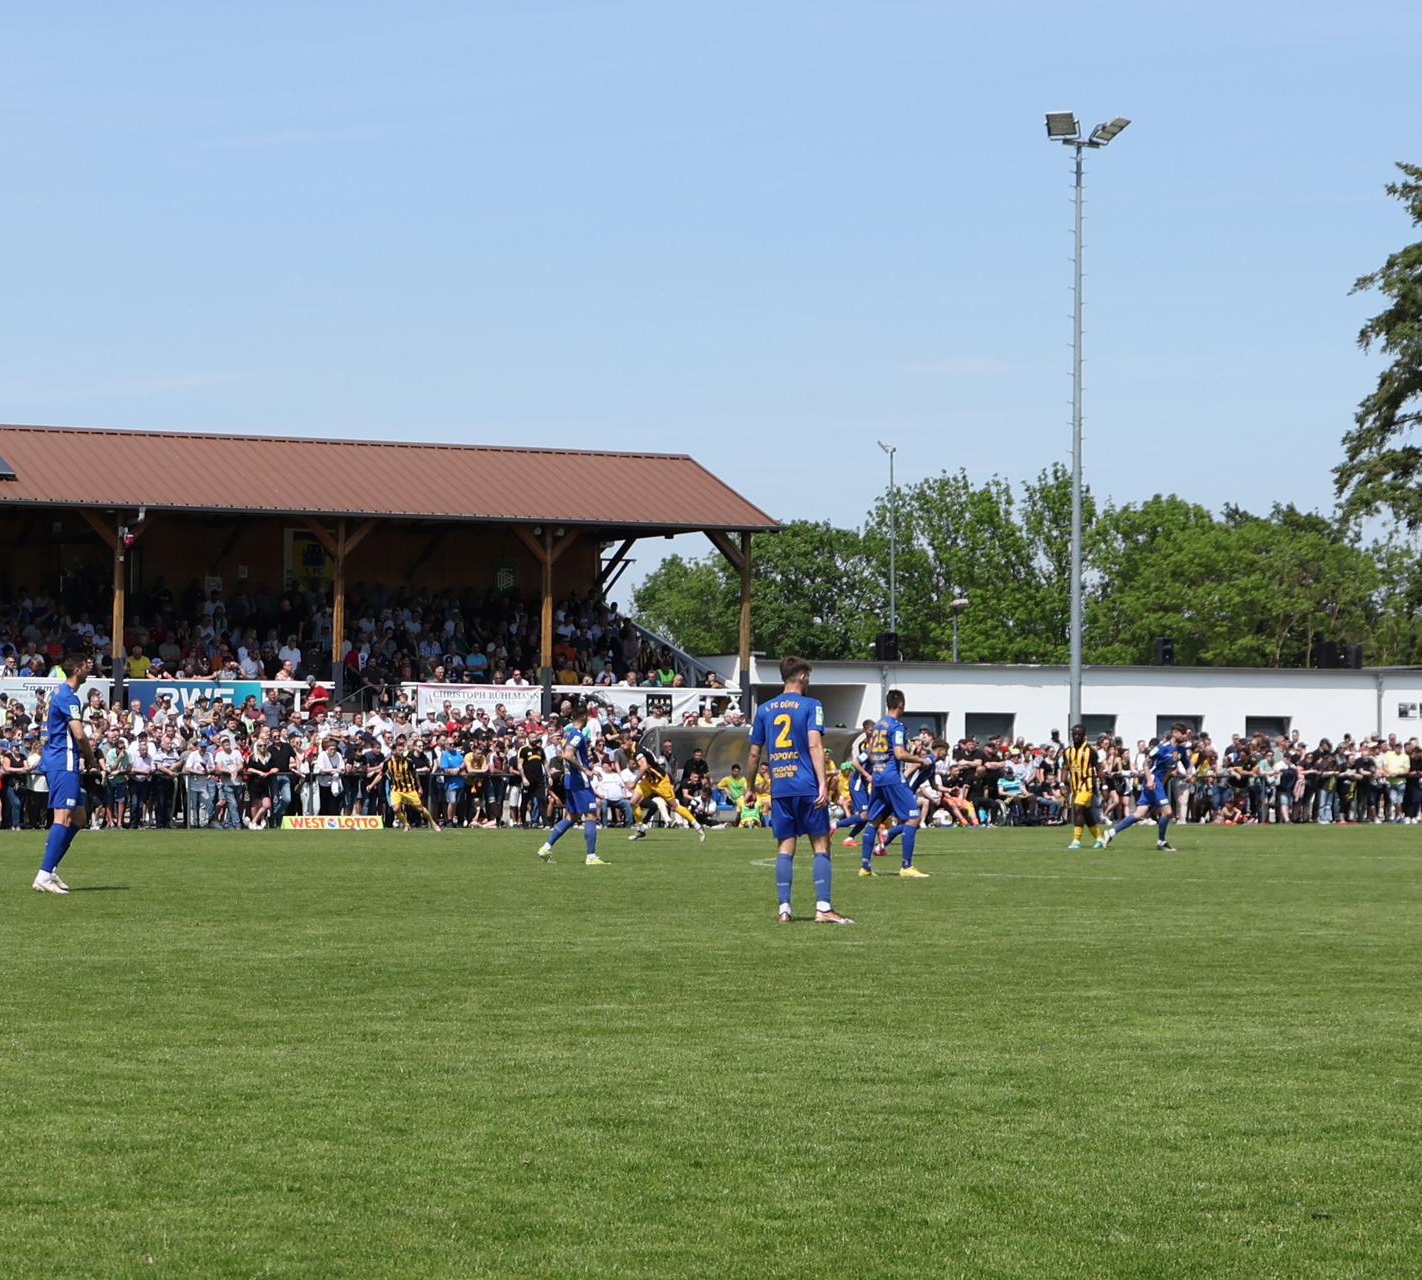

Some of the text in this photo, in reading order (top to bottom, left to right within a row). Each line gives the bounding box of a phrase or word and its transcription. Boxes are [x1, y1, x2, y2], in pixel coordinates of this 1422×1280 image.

[433, 690, 486, 698] CHRISTOPH
[156, 688, 234, 712] RWE
[770, 702, 778, 710] FC
[774, 714, 793, 748] 2
[290, 818, 378, 828] WEST LOTTO
